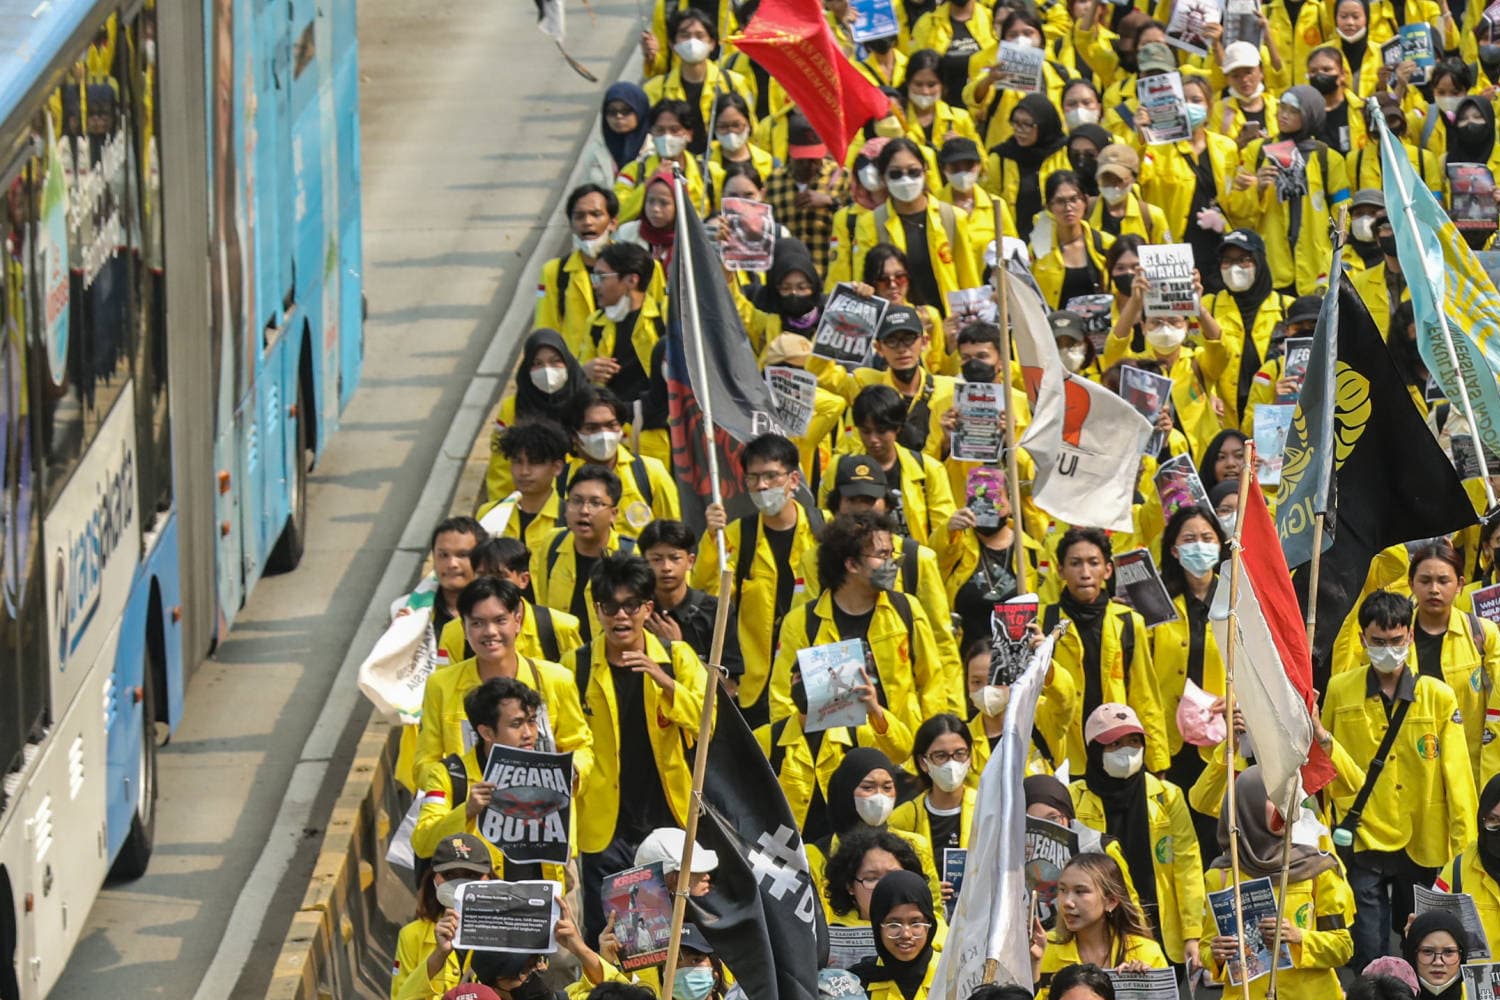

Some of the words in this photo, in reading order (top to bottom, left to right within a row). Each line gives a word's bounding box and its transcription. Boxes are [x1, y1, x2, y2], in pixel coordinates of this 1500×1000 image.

[1056, 454, 1080, 477] UI
[487, 762, 570, 797] NEGARA
[482, 808, 567, 843] BUTA
